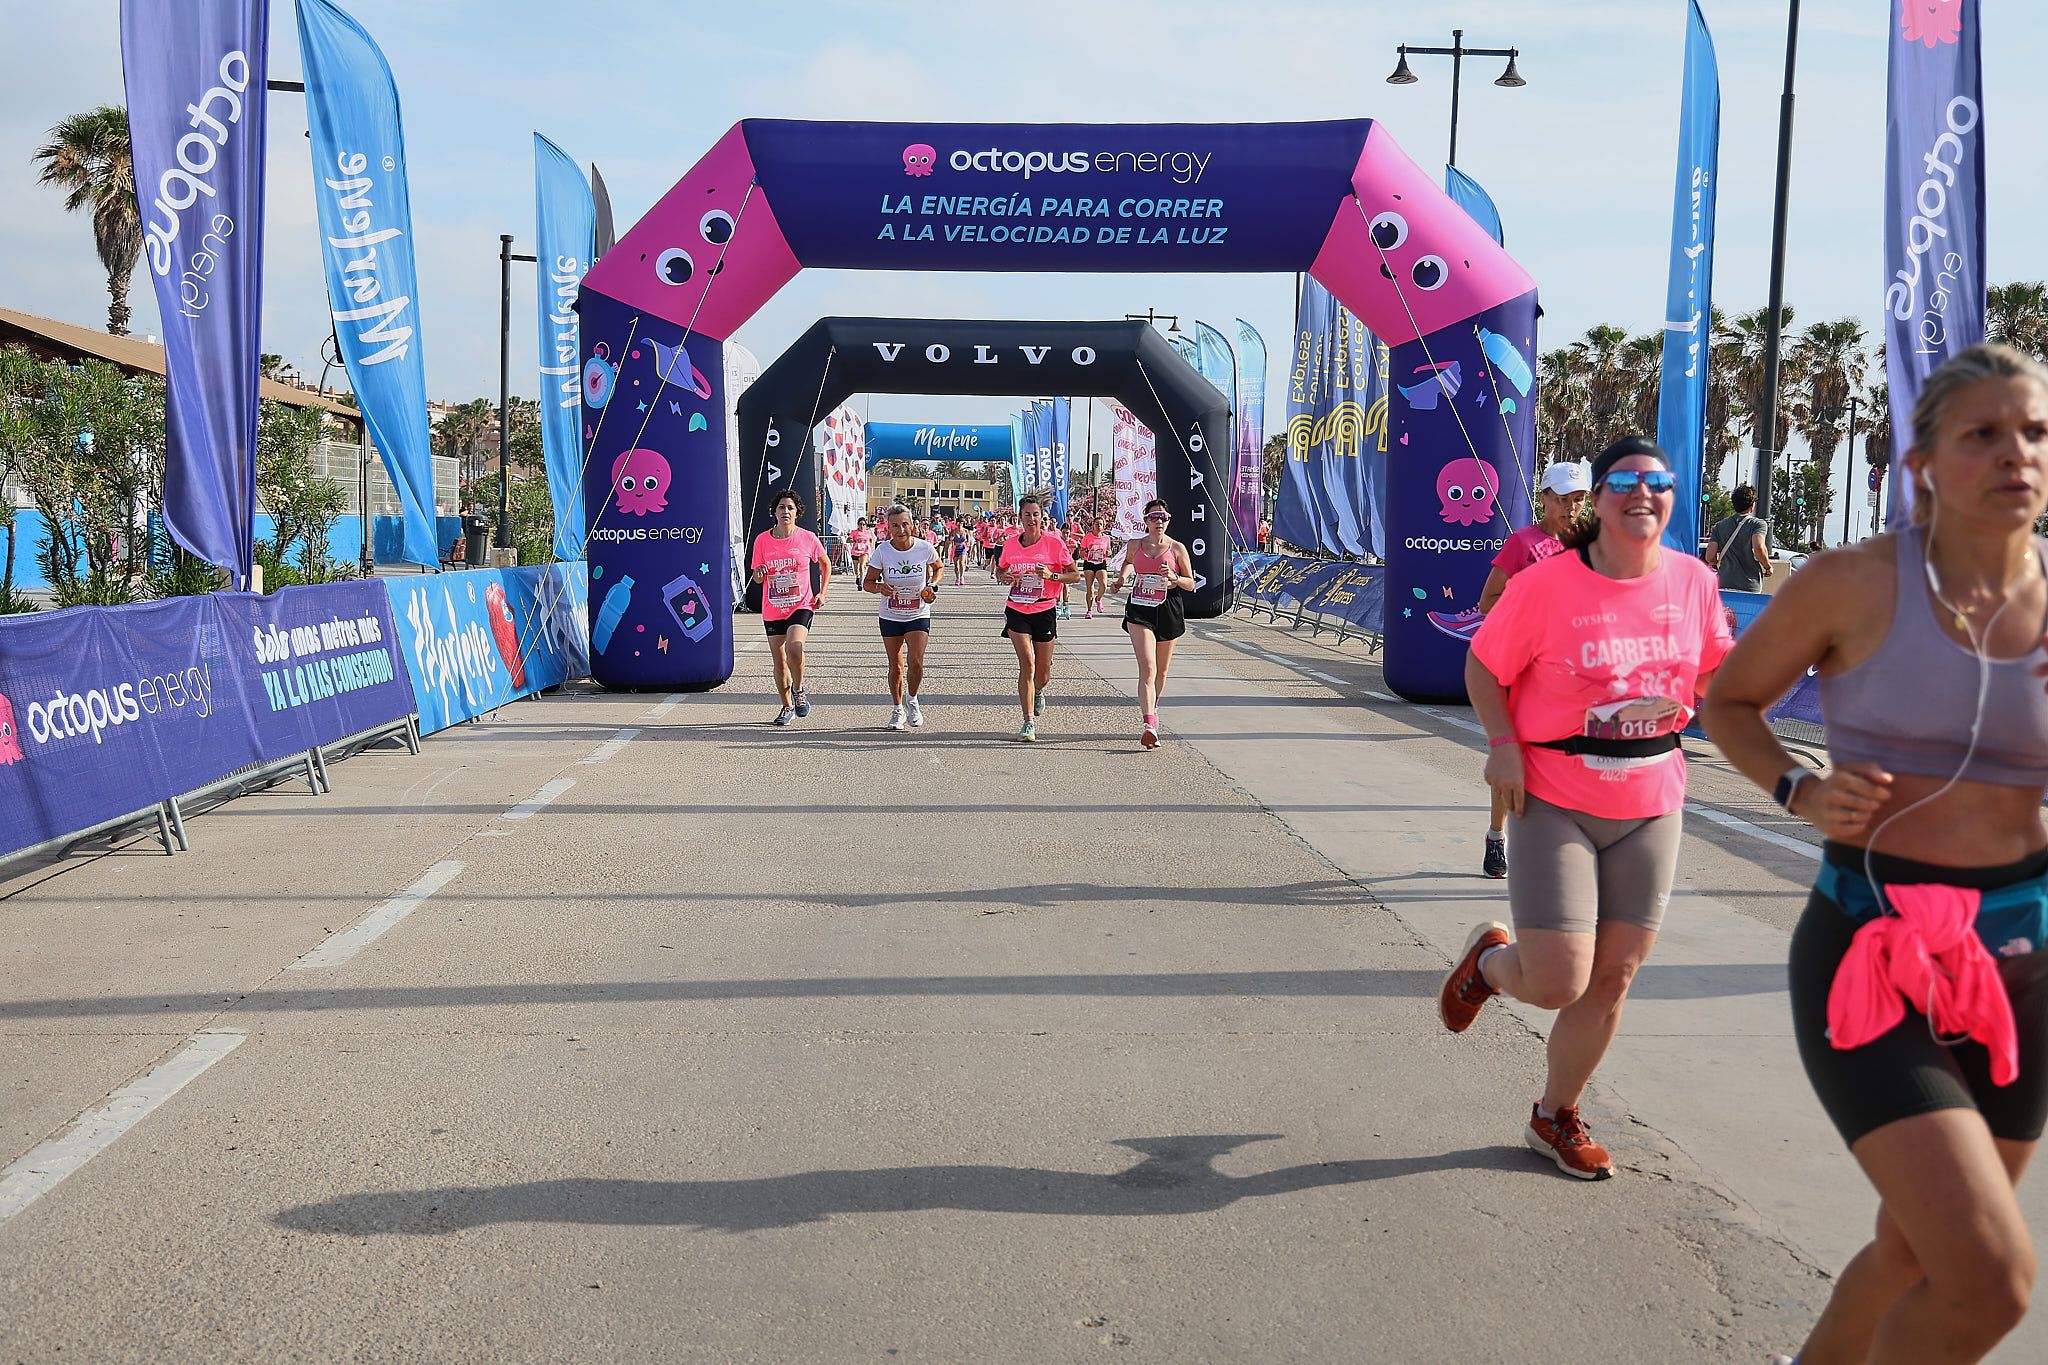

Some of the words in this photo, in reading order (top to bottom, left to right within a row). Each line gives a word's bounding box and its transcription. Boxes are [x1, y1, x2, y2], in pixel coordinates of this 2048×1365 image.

[949, 147, 1090, 180] octopus
[1094, 151, 1213, 184] energy
[880, 194, 914, 215] LA
[920, 192, 1033, 217] ENERGÍA
[1040, 197, 1110, 218] PARA
[1118, 198, 1224, 219] CORRER
[876, 223, 896, 241] A
[902, 224, 935, 242] LA
[943, 225, 1091, 244] VELOCIDAD
[1096, 227, 1130, 244] DE
[1136, 227, 1171, 244] LA
[1176, 227, 1229, 244] LUZ
[873, 342, 1097, 365] VOLVO
[914, 427, 978, 456] Marlene
[1188, 433, 1206, 593] VOLVO
[593, 527, 647, 544] octopus
[648, 526, 704, 544] energy
[1405, 536, 1472, 554] octopus
[1472, 538, 1507, 551] ene
[888, 561, 923, 575] moss
[1572, 613, 1617, 628] OYSHO
[253, 623, 290, 664] Solo
[291, 624, 321, 657] unos
[320, 615, 360, 650] metros
[357, 609, 382, 643] más
[407, 586, 496, 726] Marlene
[1582, 635, 1682, 669] CARRERA
[262, 671, 287, 712] YA
[305, 659, 335, 701] HAS
[330, 647, 394, 694] CONSEGUIDO
[27, 678, 139, 745] octopus
[137, 661, 213, 718] energy
[1621, 720, 1657, 737] 016
